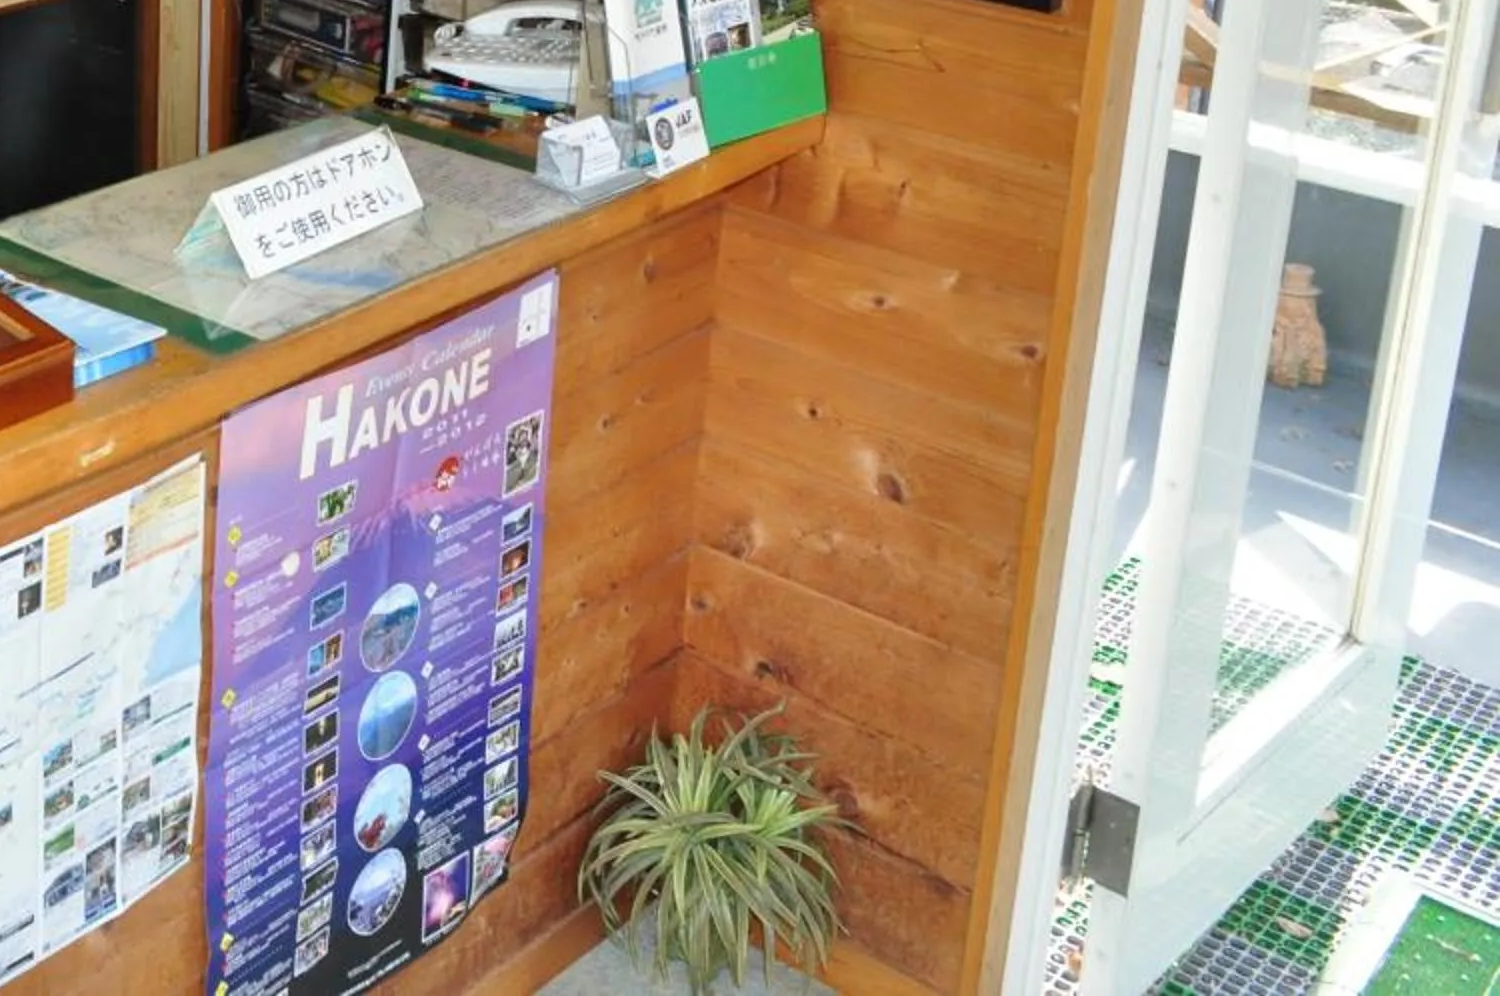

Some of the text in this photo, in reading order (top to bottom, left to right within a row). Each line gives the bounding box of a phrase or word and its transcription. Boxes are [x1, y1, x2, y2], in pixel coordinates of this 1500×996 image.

[233, 143, 392, 220] 御用の方はドアホン
[255, 185, 405, 259] をご使用ください。
[299, 347, 493, 481] HAKONE
